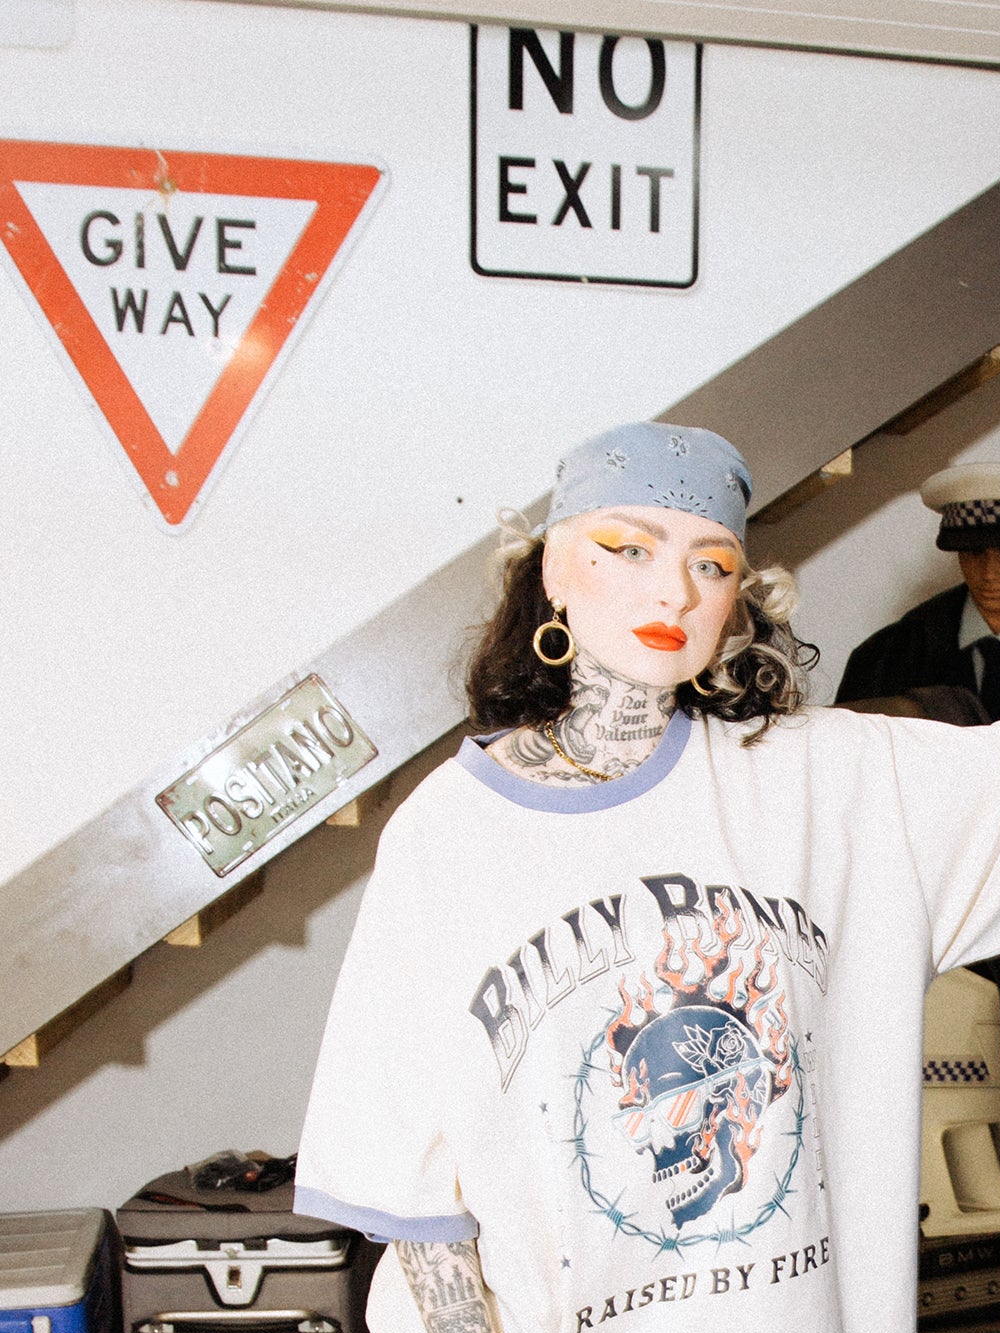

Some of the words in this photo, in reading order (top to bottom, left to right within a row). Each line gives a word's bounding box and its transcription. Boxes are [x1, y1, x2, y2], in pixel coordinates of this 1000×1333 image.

[507, 28, 667, 121] NO
[498, 156, 675, 233] EXIT
[79, 210, 257, 276] GIVE
[110, 287, 233, 338] WAY
[181, 705, 354, 855] POSITANO
[468, 893, 637, 1094] BILLY
[708, 1262, 756, 1296] BY
[769, 1236, 831, 1285] FIRE
